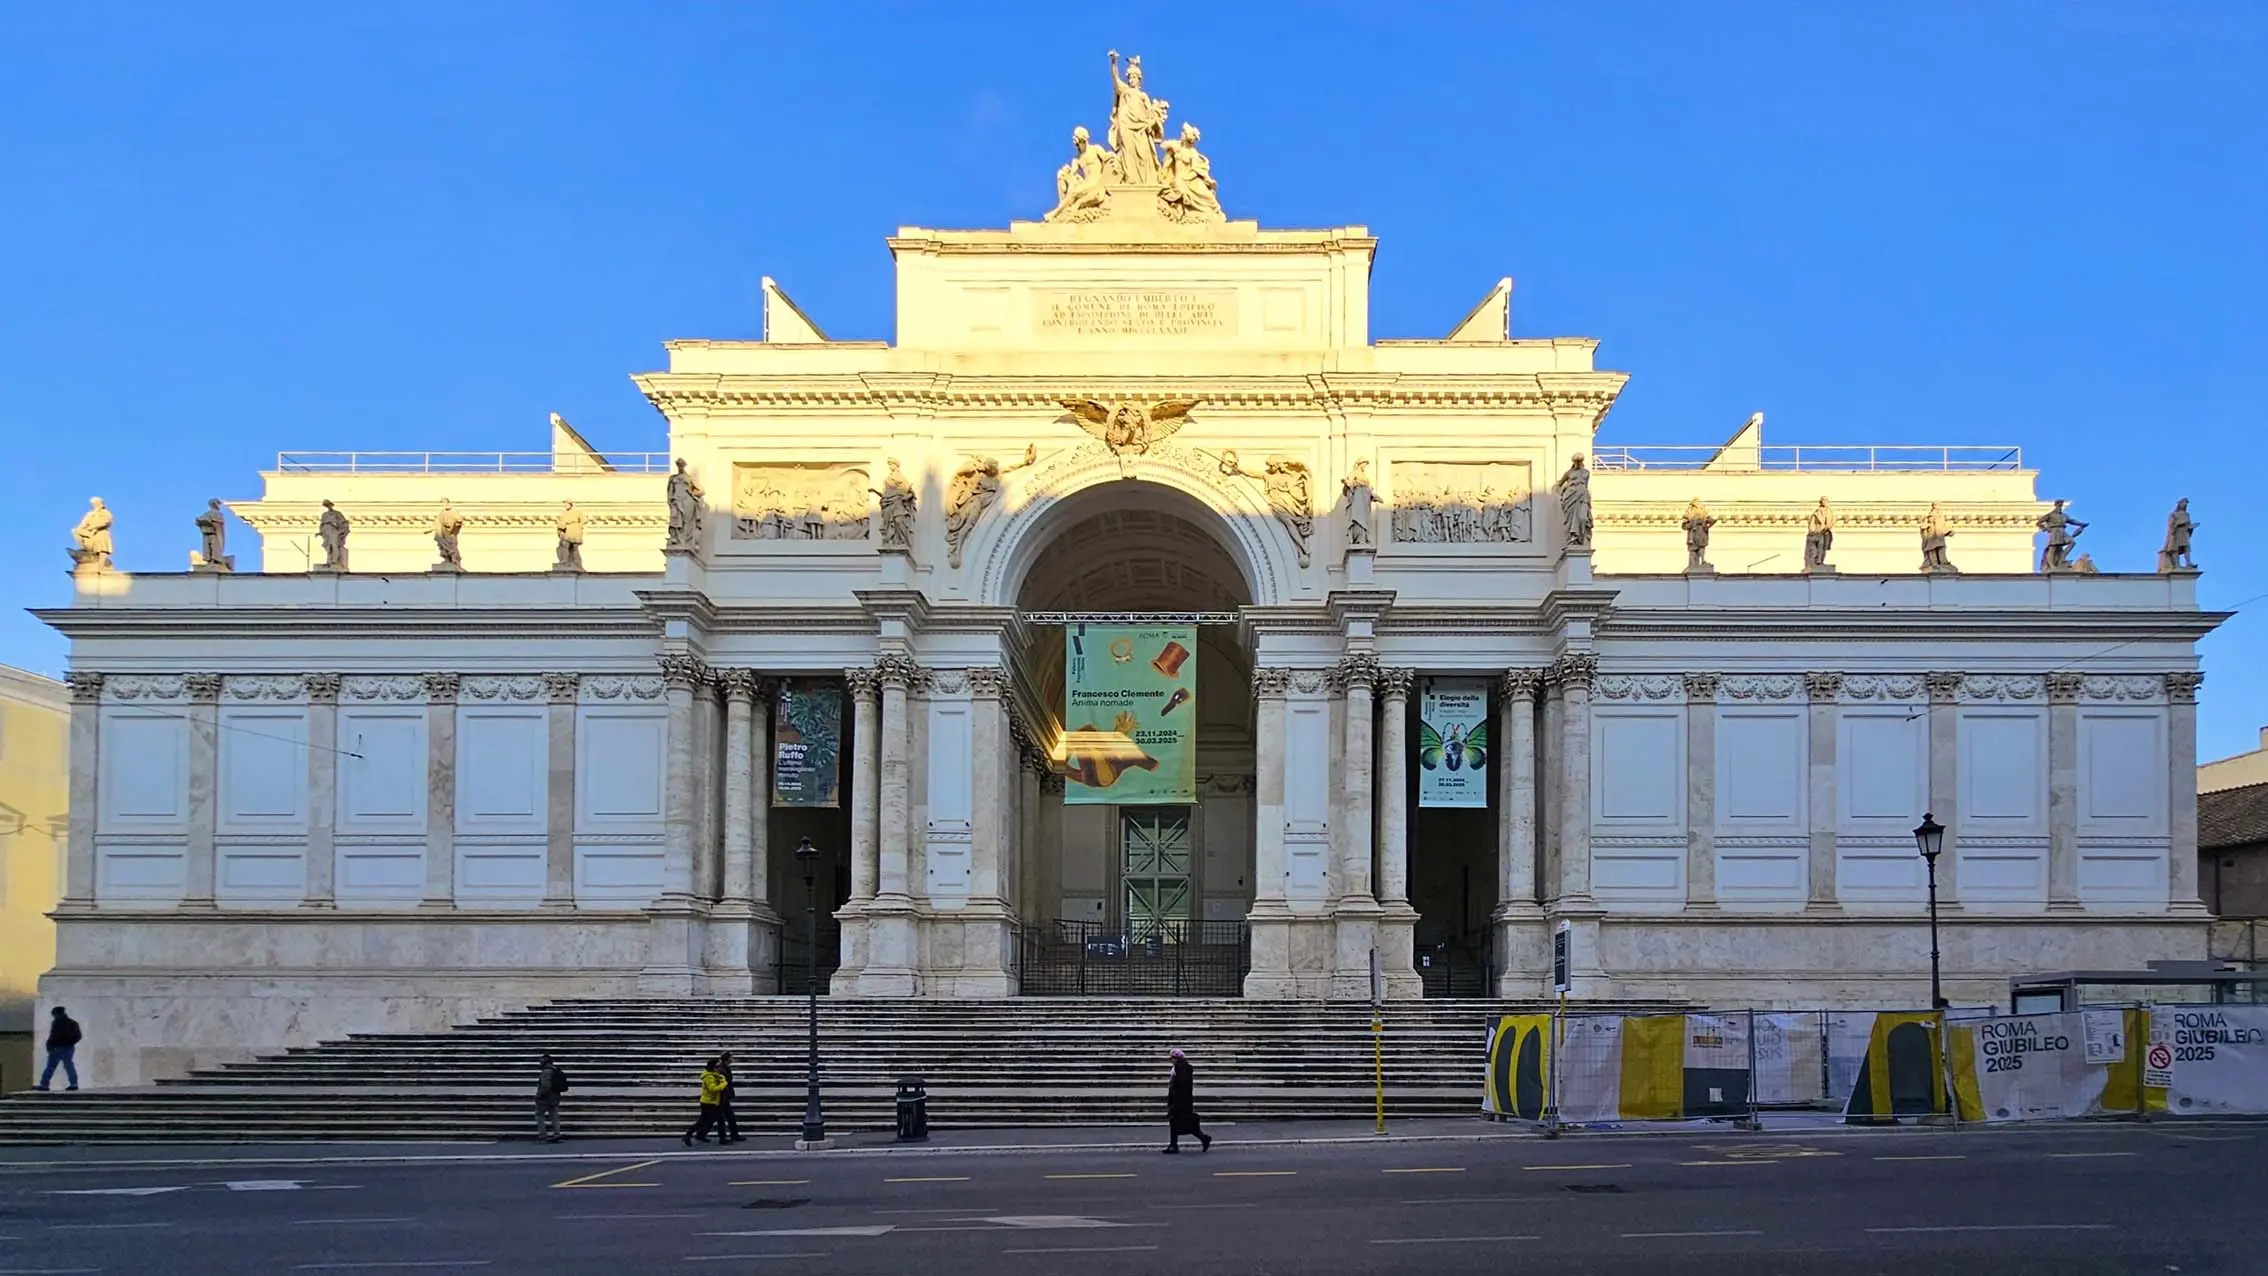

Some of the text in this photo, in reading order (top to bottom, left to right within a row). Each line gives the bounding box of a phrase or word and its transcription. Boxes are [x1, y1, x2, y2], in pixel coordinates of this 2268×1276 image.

[1072, 689, 1165, 698] Francesco Clemente
[779, 743, 808, 751] Pietro
[779, 751, 804, 759] Ruffo
[2174, 1011, 2227, 1028] ROMA
[1982, 1021, 2037, 1040] ROMA
[2175, 1028, 2265, 1044] GIUBILEO
[1983, 1035, 2069, 1056] GIUBILEO
[2175, 1046, 2215, 1062] 2025
[1985, 1055, 2022, 1073] 2025
